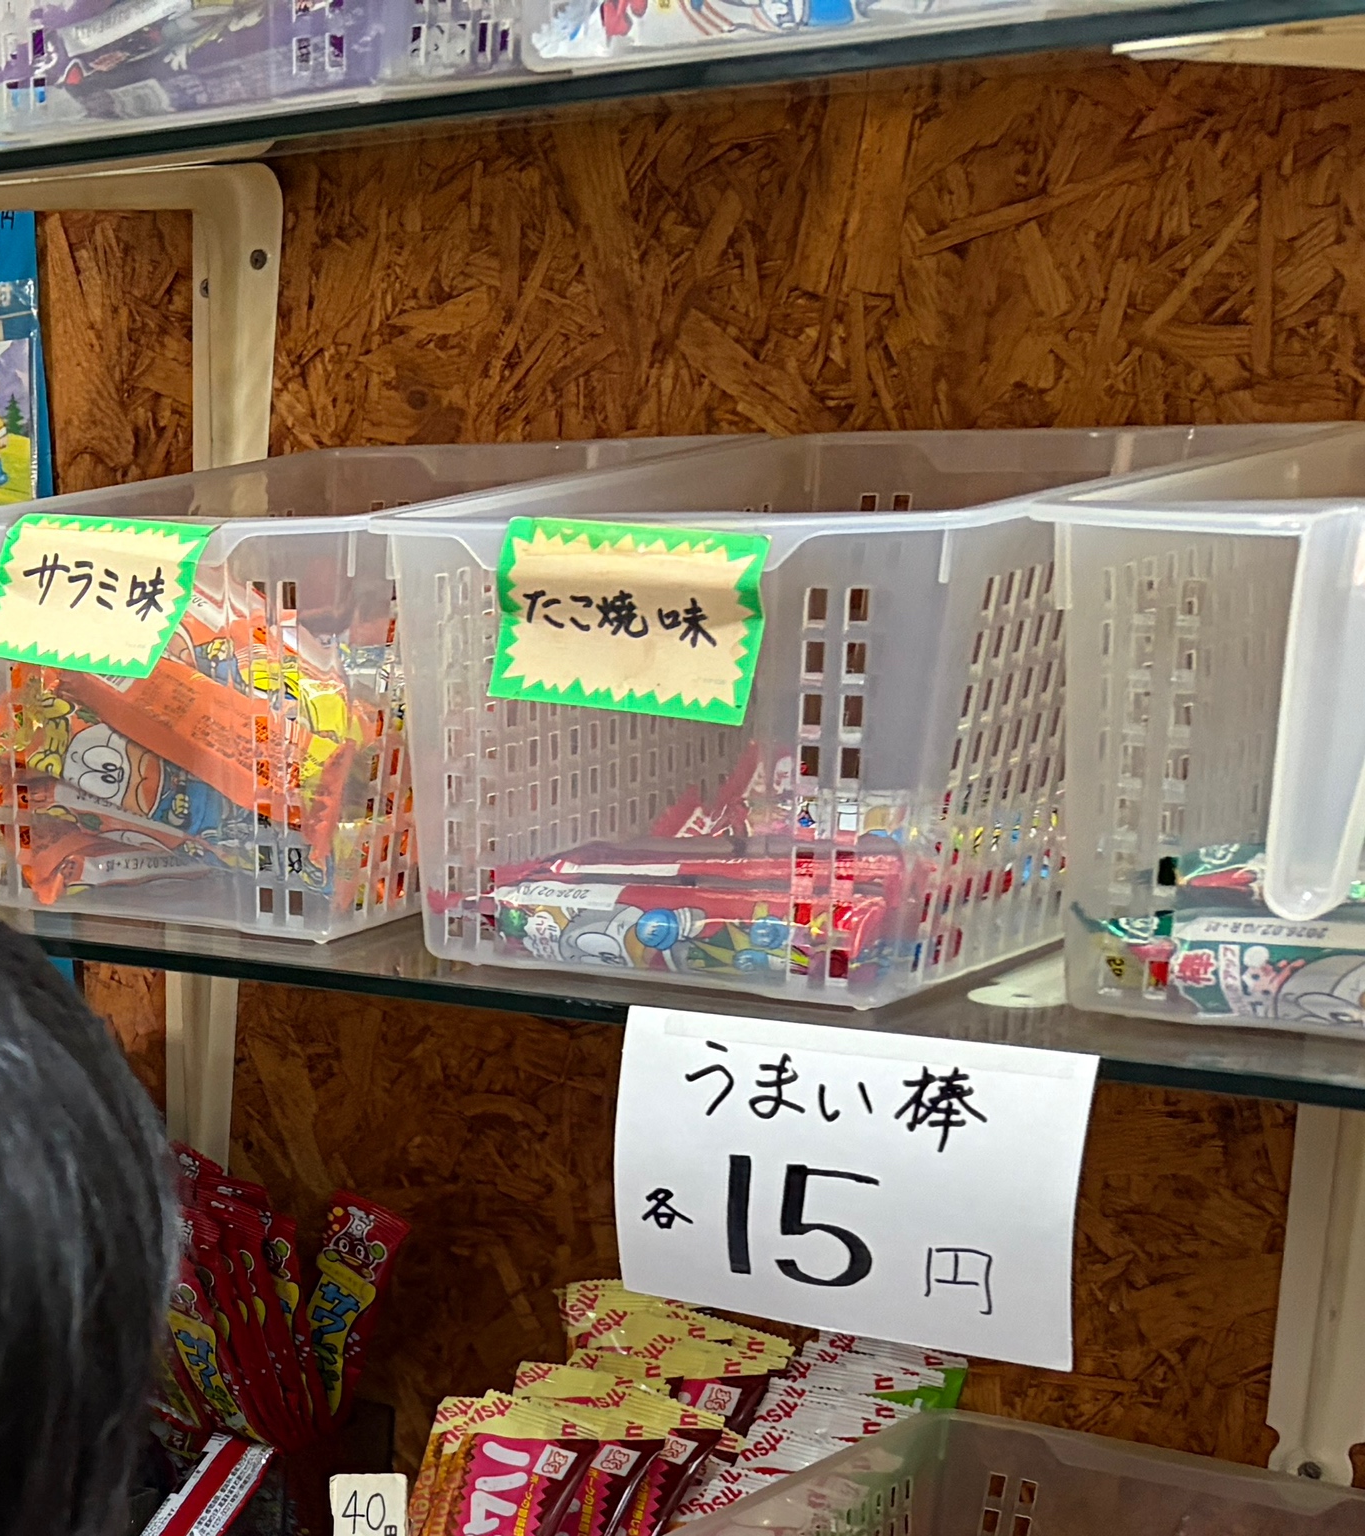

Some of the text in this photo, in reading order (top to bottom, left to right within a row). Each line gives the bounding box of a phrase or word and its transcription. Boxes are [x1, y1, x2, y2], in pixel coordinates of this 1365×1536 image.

[22, 552, 166, 623] サラミ味
[523, 589, 718, 649] たこ焼味
[684, 1040, 988, 1153] うまい棒
